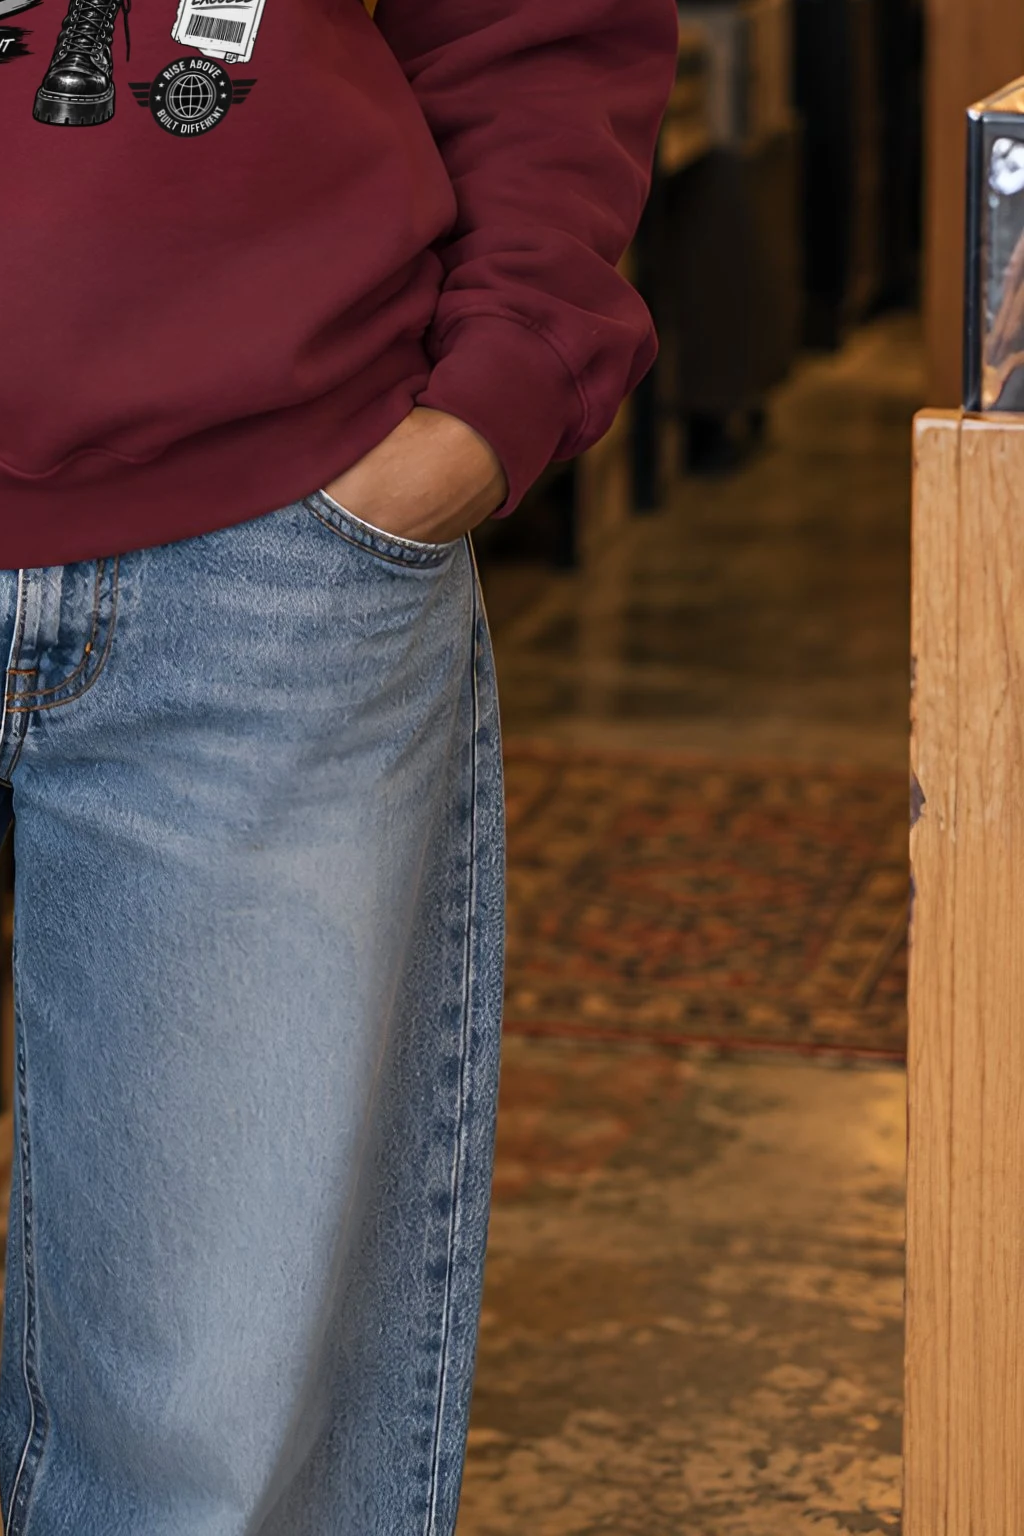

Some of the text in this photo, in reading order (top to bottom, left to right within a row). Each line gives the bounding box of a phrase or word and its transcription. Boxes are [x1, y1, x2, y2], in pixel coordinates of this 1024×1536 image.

[163, 59, 222, 80] RISE ABOVE
[156, 106, 224, 134] BUILT DIFFERENT
